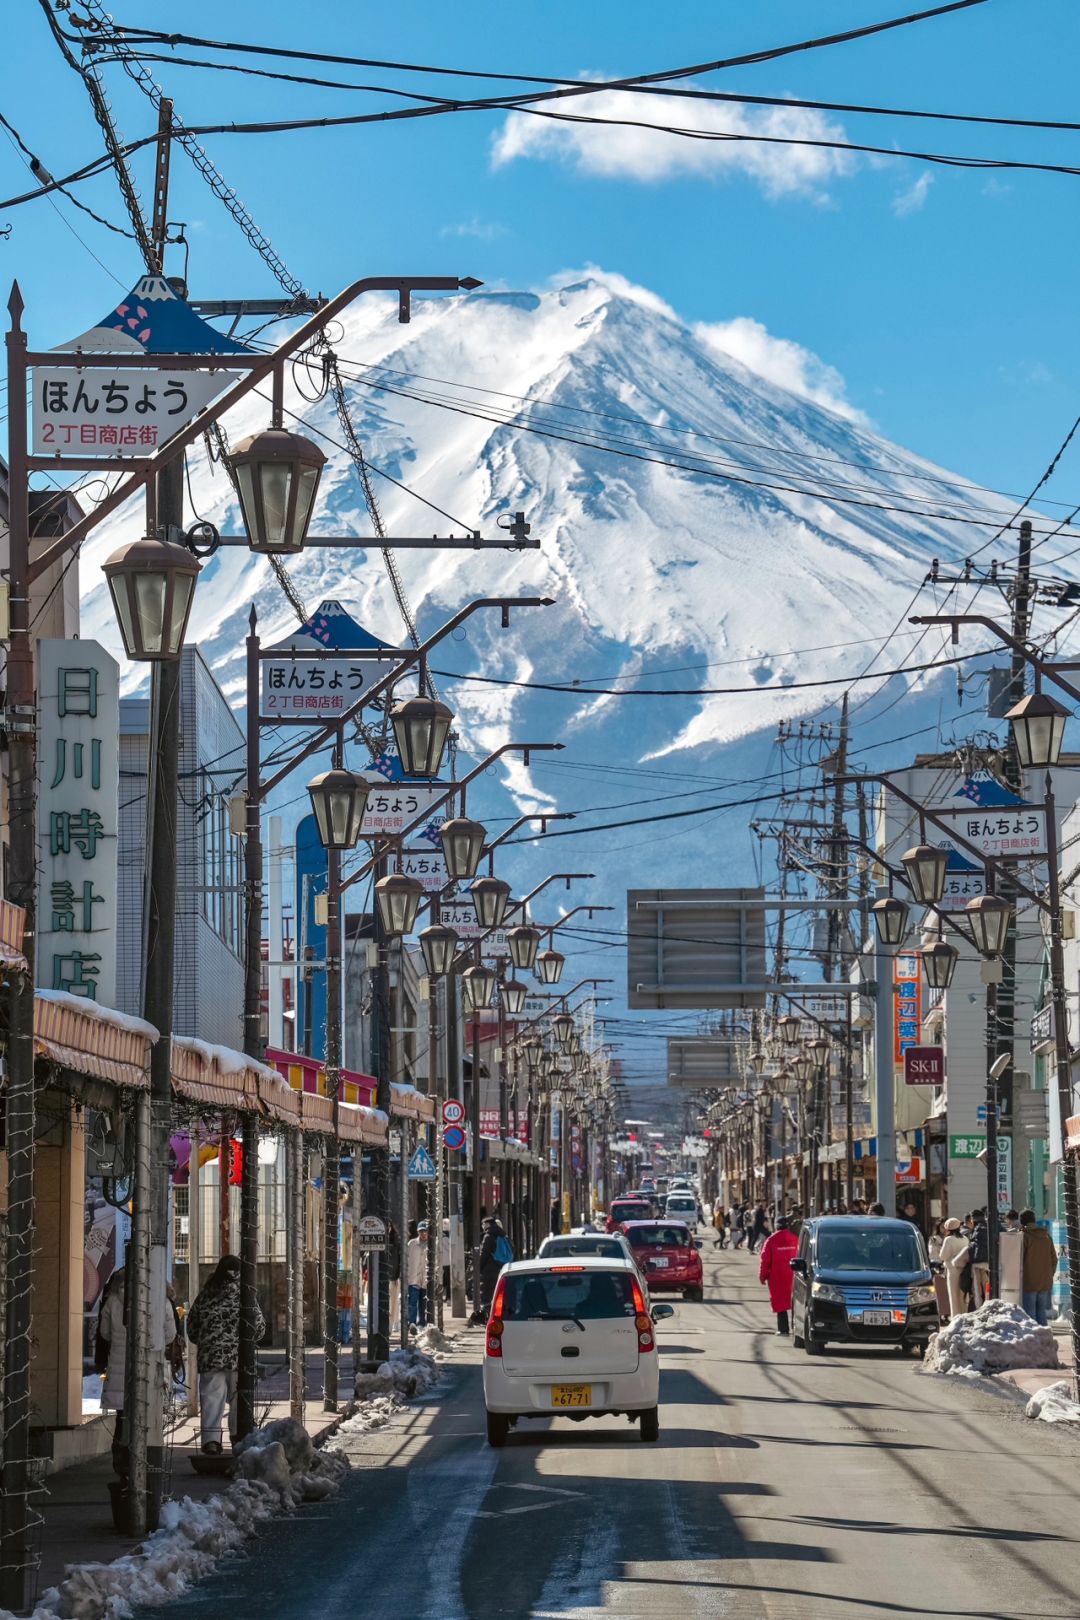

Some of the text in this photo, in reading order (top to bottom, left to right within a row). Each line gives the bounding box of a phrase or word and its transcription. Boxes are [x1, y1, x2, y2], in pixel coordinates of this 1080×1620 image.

[42, 378, 189, 416] ほんちょう
[42, 423, 159, 446] 2丁目商店街
[268, 666, 364, 690] ほんちょう
[268, 694, 344, 709] 2丁目商店街
[50, 666, 106, 1000] 日川時計店
[967, 816, 1040, 837] ほんちょう
[983, 837, 1040, 850] 2丁目商店街
[910, 1060, 939, 1072] SK-II
[447, 1106, 460, 1118] 40
[955, 1138, 986, 1154] 渡辺
[560, 1393, 589, 1405] 67-71
